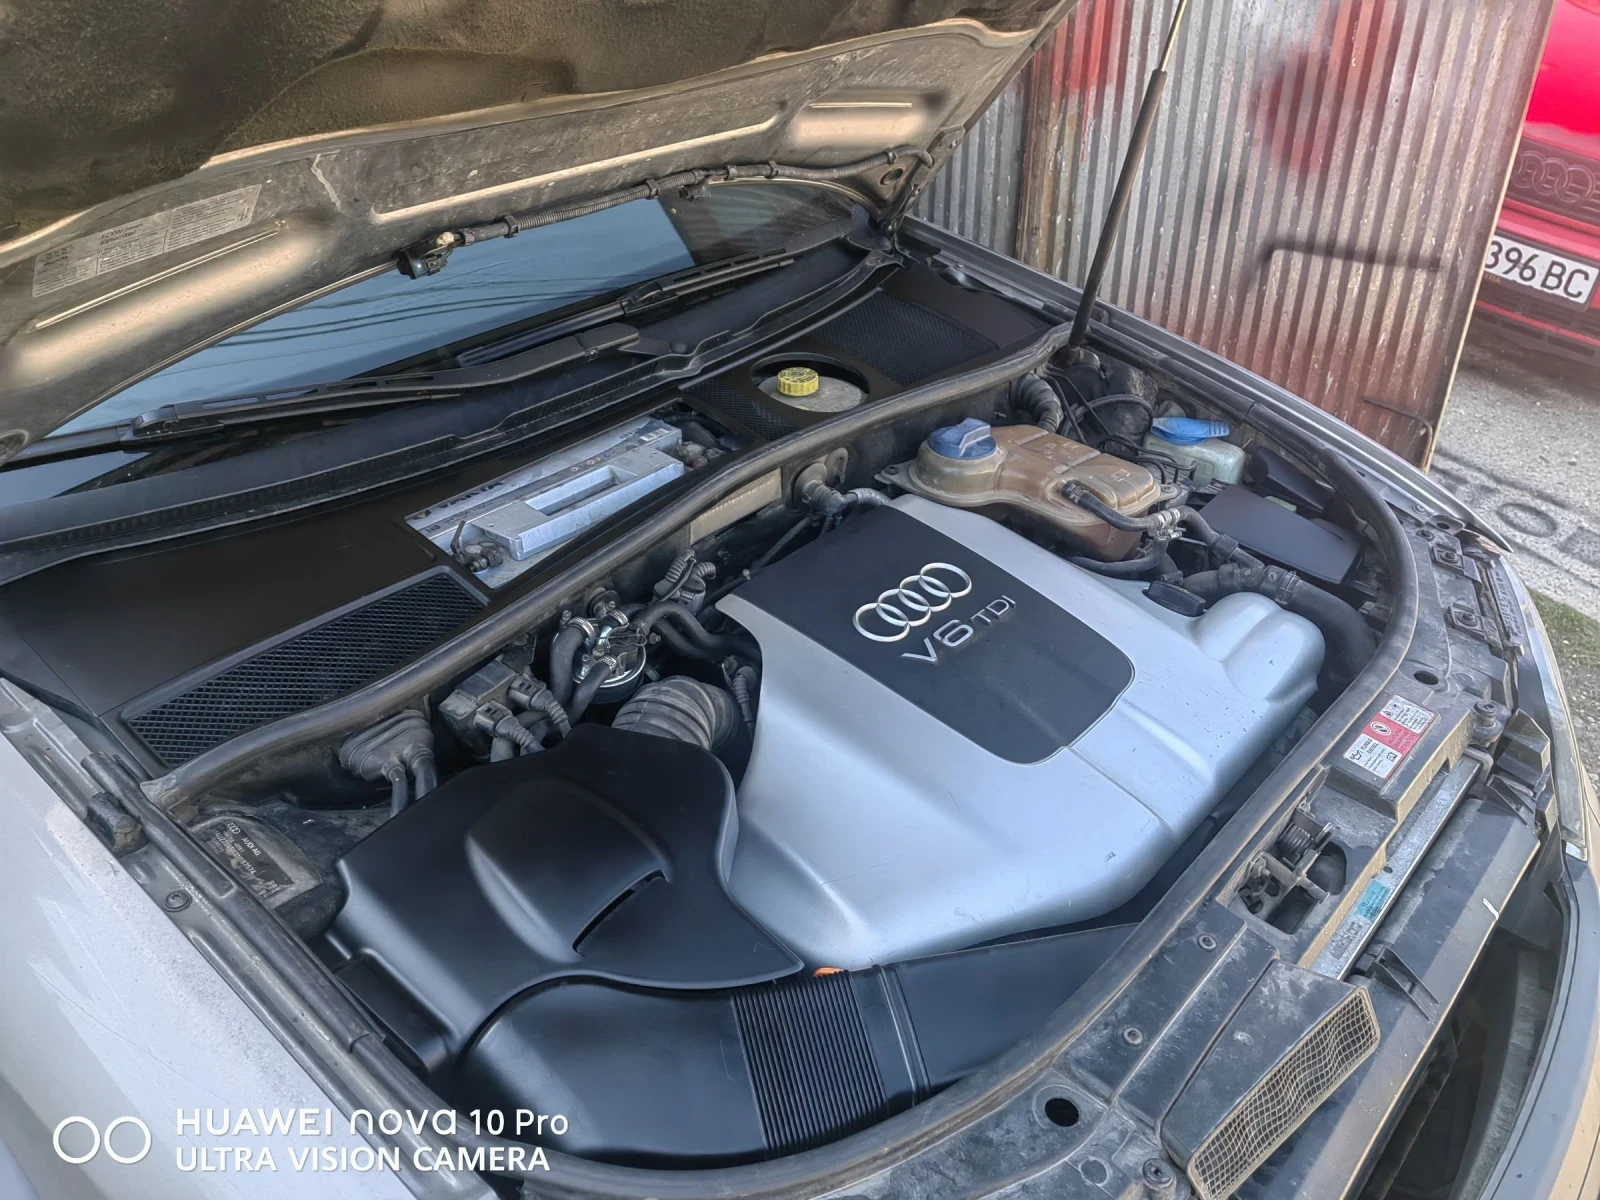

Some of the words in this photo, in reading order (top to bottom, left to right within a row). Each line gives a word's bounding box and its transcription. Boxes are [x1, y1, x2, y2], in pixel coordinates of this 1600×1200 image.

[1485, 240, 1540, 282] 396
[901, 618, 975, 667] V6
[969, 594, 1017, 626] TDI
